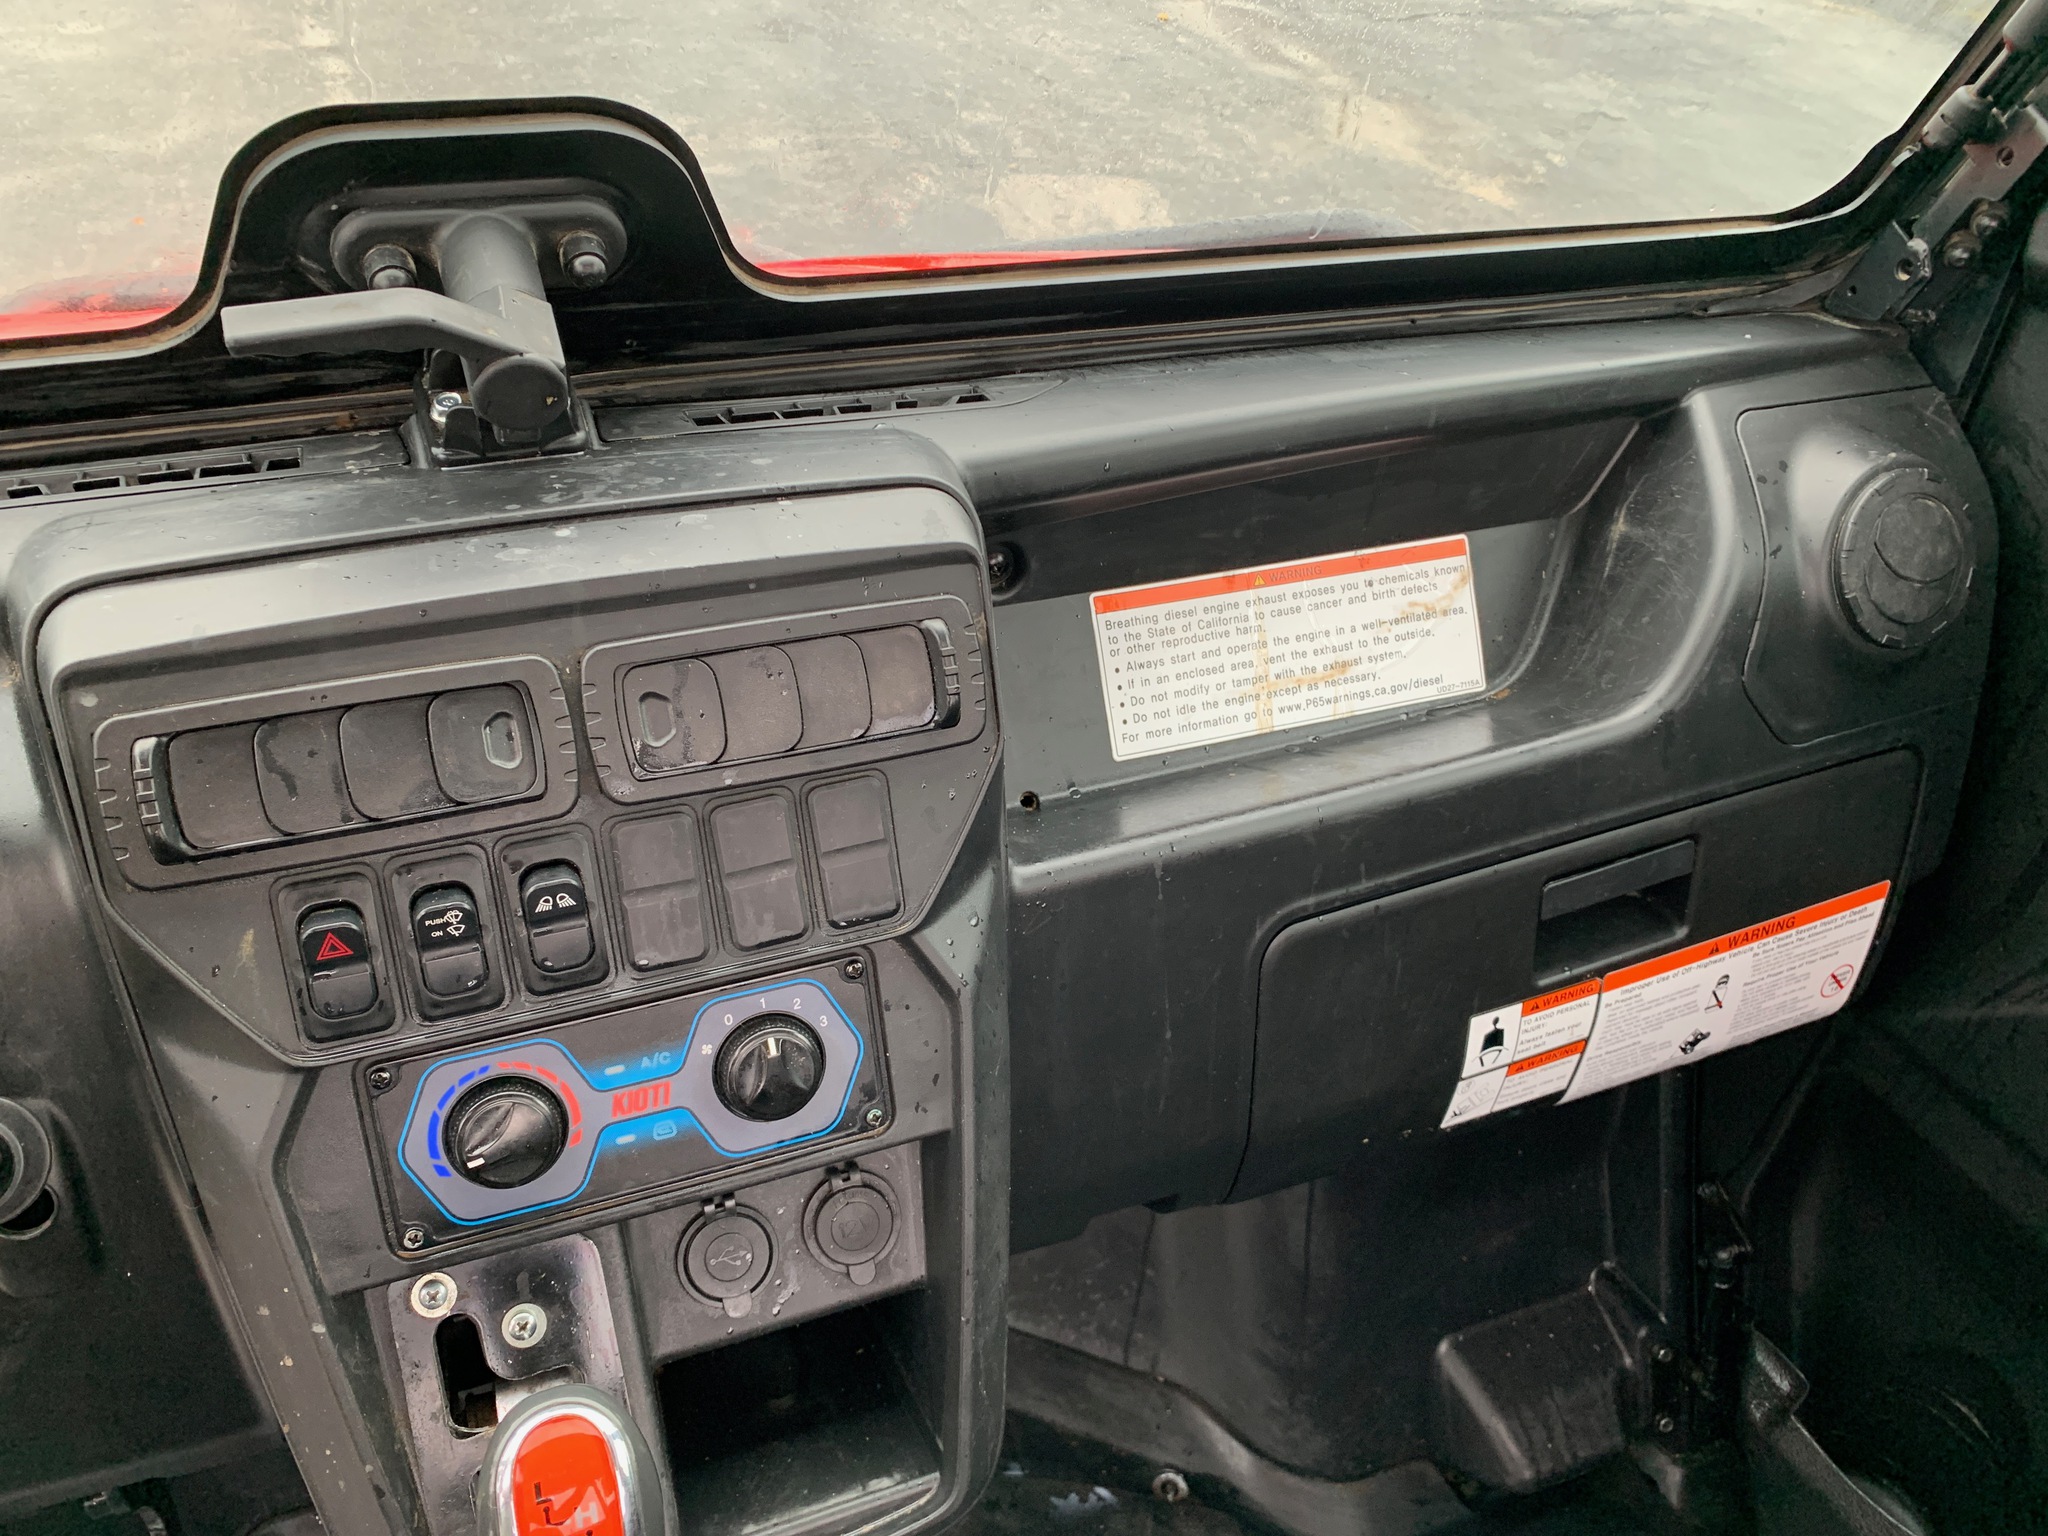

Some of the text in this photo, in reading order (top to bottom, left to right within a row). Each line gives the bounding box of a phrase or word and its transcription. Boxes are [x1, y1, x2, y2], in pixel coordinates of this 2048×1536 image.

[1269, 565, 1322, 583] WARNING
[1104, 564, 1464, 630] Breathing diesel engine exhaust exposes you to chemicals known
[1107, 581, 1437, 645] to the State of California to cause cancer and birth defects
[1109, 624, 1266, 657] or other reproductive harm.
[1126, 606, 1467, 672] Always start and operate the engine in a well-ventilated area.
[1127, 678, 1134, 689] If
[1140, 676, 1150, 687] in
[1156, 674, 1169, 684] an
[1175, 662, 1224, 681] enclosed
[1262, 652, 1285, 665] vent
[1290, 649, 1307, 660] the
[1312, 640, 1353, 656] exhaust
[1357, 639, 1368, 648] to
[1372, 635, 1389, 645] the
[1394, 627, 1434, 642] outside.
[1130, 650, 1406, 706] Do not modify or tamper with the exhaust system.
[1436, 679, 1480, 694] UD27-7115A
[1121, 673, 1443, 743] For more information go to www.P65warnings.ca.gov/diesel
[1132, 671, 1380, 723] Do not idle the engine except as necessary.
[425, 917, 447, 926] PUSH
[431, 930, 443, 938] ON
[1728, 916, 1796, 949] WARNING
[1620, 980, 1654, 996] Improper
[1656, 974, 1670, 984] Use
[1672, 970, 1680, 979] of
[1729, 945, 1754, 958] Vehicle
[1757, 940, 1771, 950] Can
[1794, 924, 1818, 937] Severe
[1849, 906, 1868, 917] Death
[1534, 1011, 1555, 1022] AVOID
[1556, 1000, 1590, 1015] PERSONAL
[1542, 983, 1594, 1007] WARNING
[724, 997, 828, 1027] 0 1 2 3
[640, 1051, 672, 1069] A/C
[1527, 1045, 1579, 1068] WARNING
[611, 1080, 672, 1119] KIOTI
[534, 1482, 552, 1505] L
